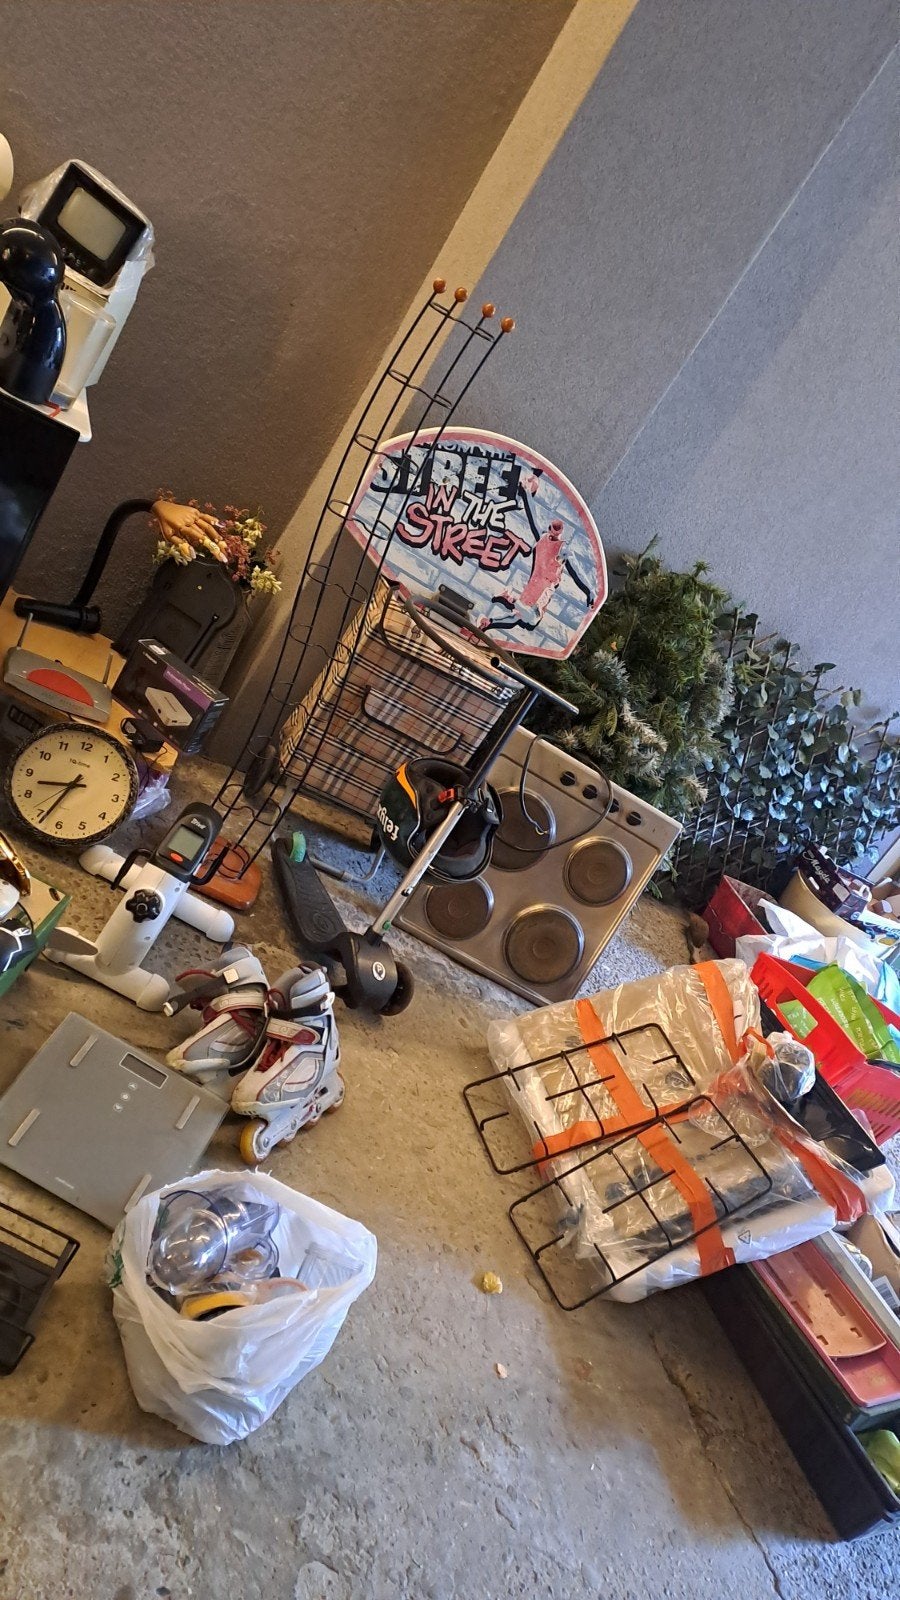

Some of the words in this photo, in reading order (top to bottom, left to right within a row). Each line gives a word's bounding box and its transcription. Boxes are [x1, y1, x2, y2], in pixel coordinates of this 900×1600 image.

[425, 482, 458, 516] IN
[460, 489, 518, 533] THE
[396, 502, 533, 572] STREET
[59, 741, 69, 752] 11
[80, 741, 94, 752] 12
[39, 750, 52, 762] 10
[103, 755, 109, 764] 1
[25, 768, 34, 777] 9
[111, 772, 120, 782] 2
[24, 789, 33, 799] 8
[111, 794, 120, 803] 3
[36, 808, 45, 818] 7
[98, 811, 107, 821] 4
[55, 820, 63, 830] 6
[78, 821, 87, 831] 5
[803, 852, 831, 884] Magda
